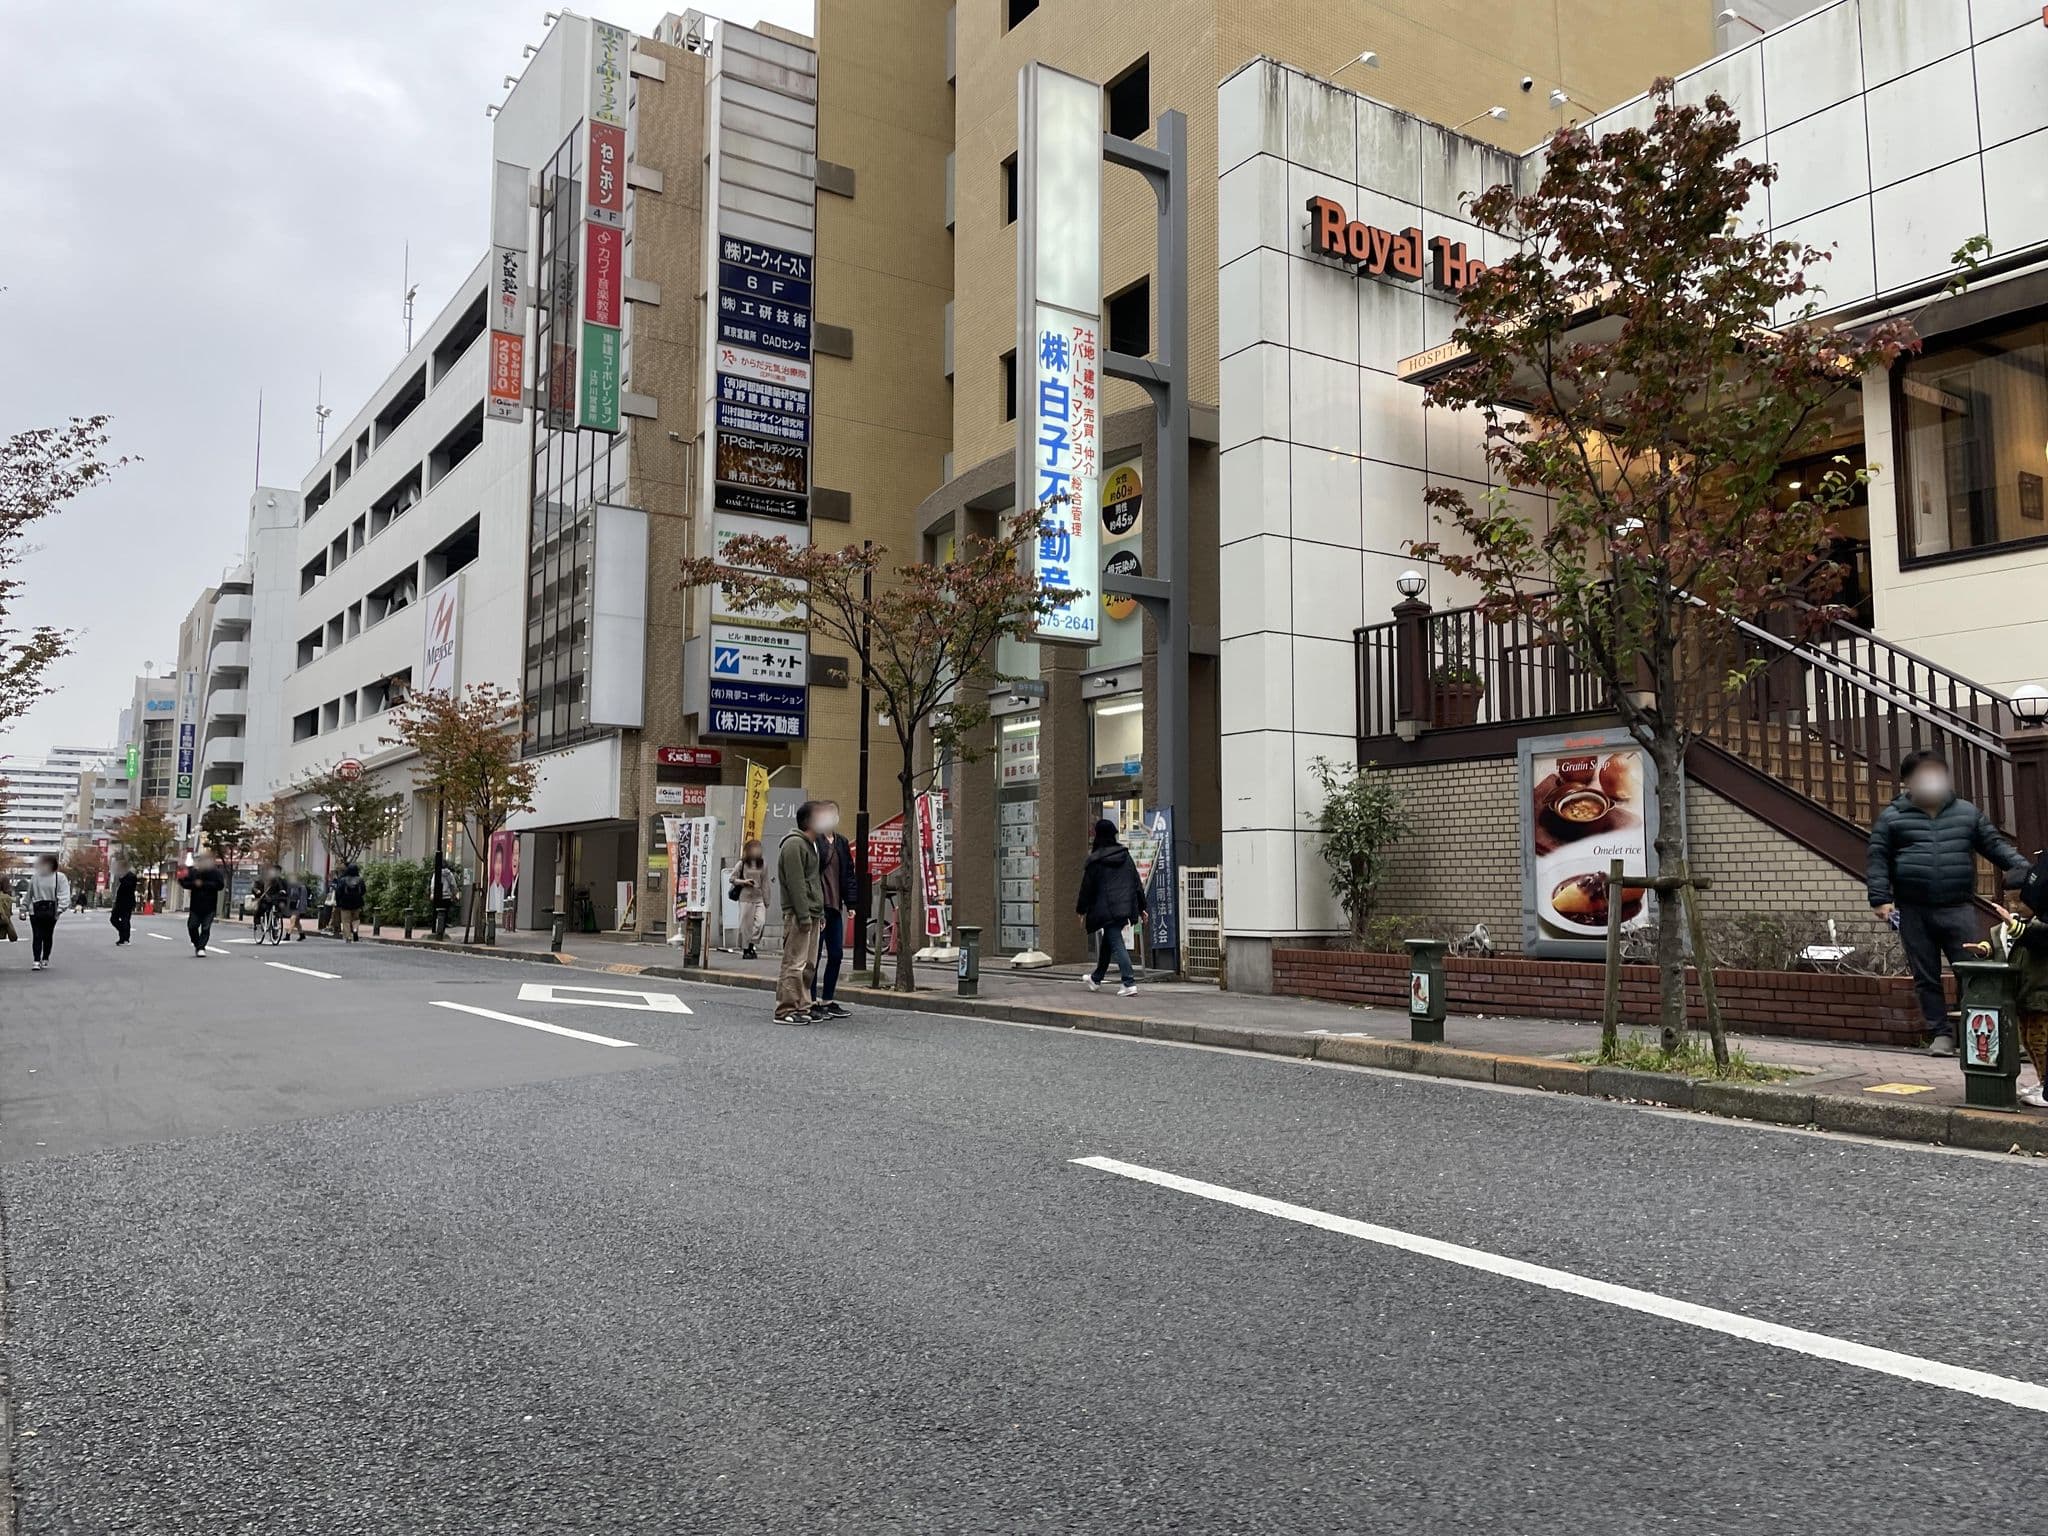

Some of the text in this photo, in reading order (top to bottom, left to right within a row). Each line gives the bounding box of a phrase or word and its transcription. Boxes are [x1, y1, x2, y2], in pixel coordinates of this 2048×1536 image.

[1307, 196, 1423, 282] Royal
[596, 247, 610, 322] カワイ音楽教室
[741, 357, 808, 380] からだ元気治療院
[762, 653, 802, 669] ネット
[715, 710, 800, 736] (株)白子不動産
[1561, 760, 1589, 773] Gratin
[745, 769, 763, 841] ヘアカラー専門
[1593, 846, 1641, 856] Omelet rice
